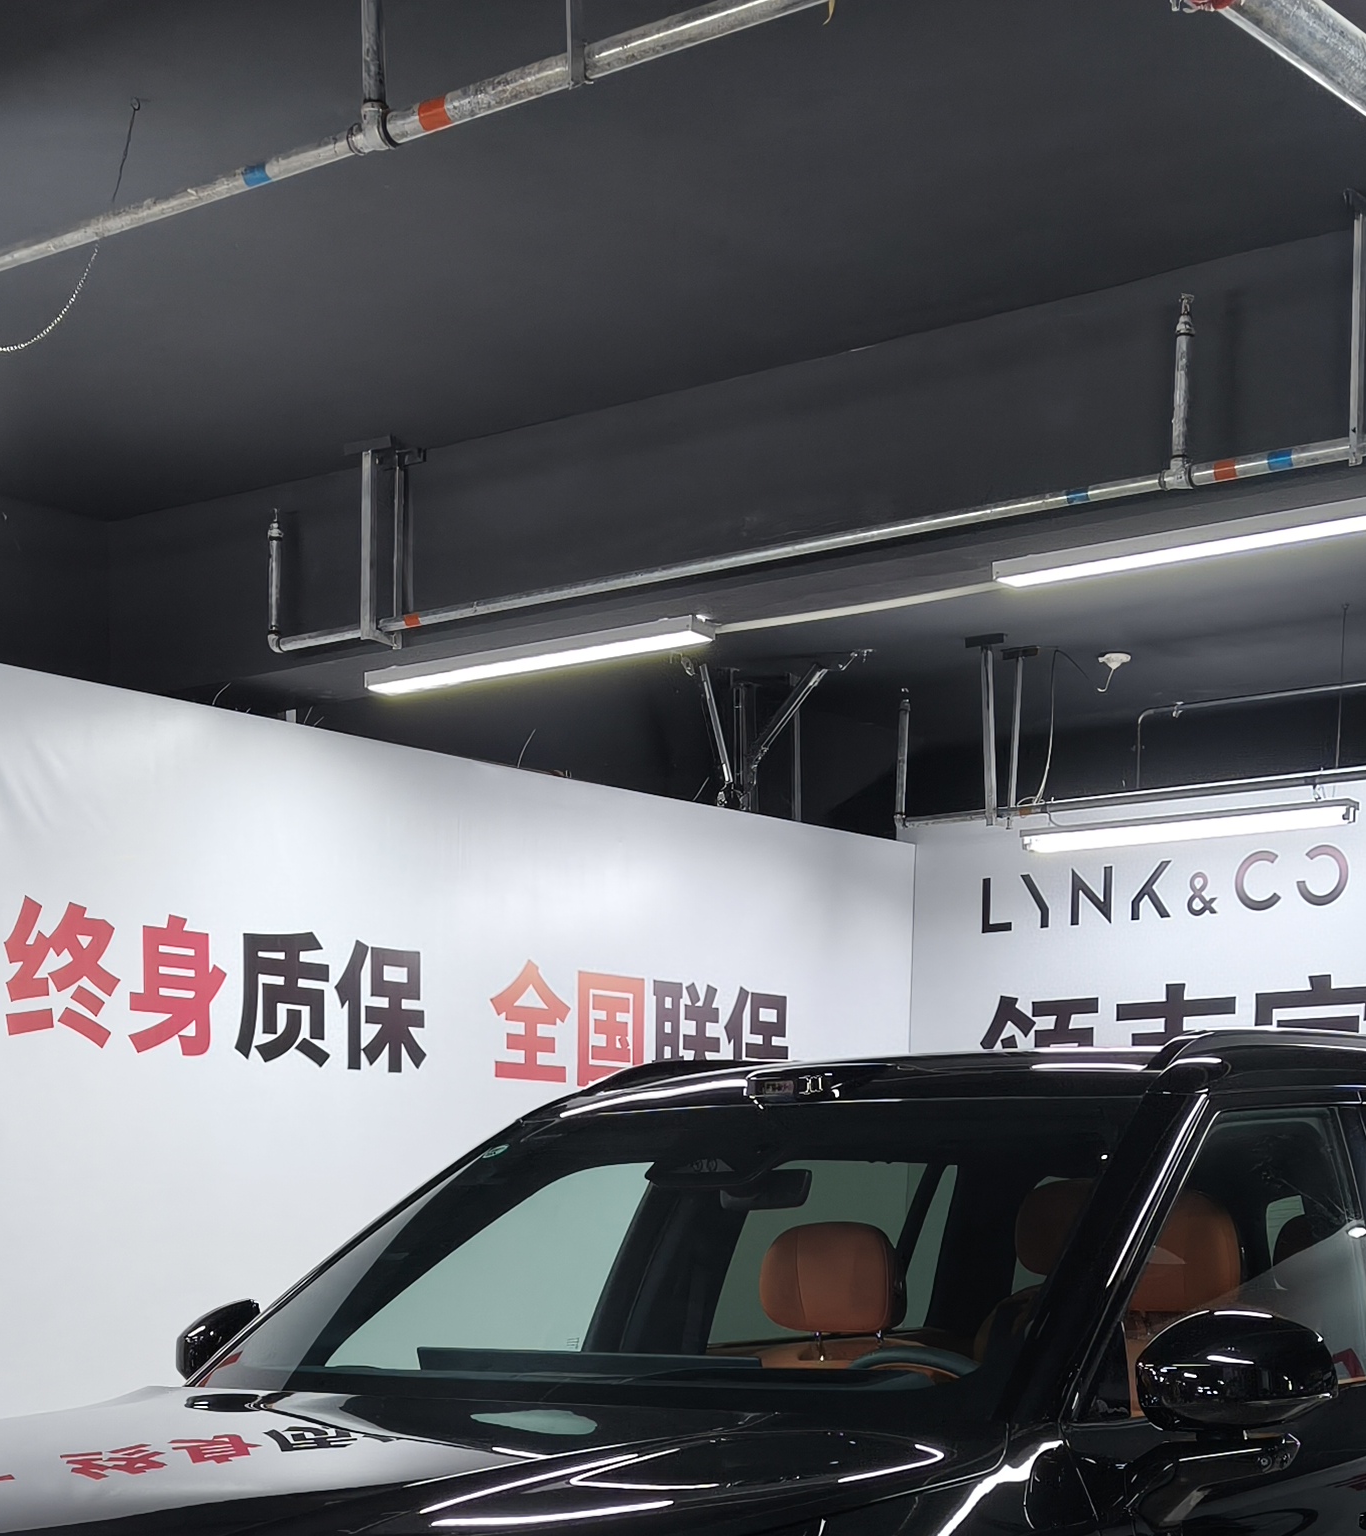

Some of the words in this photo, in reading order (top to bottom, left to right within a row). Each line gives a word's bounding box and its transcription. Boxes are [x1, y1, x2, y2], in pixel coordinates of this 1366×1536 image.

[4, 895, 426, 1073] 终身质保
[490, 958, 790, 1087] 全国联保
